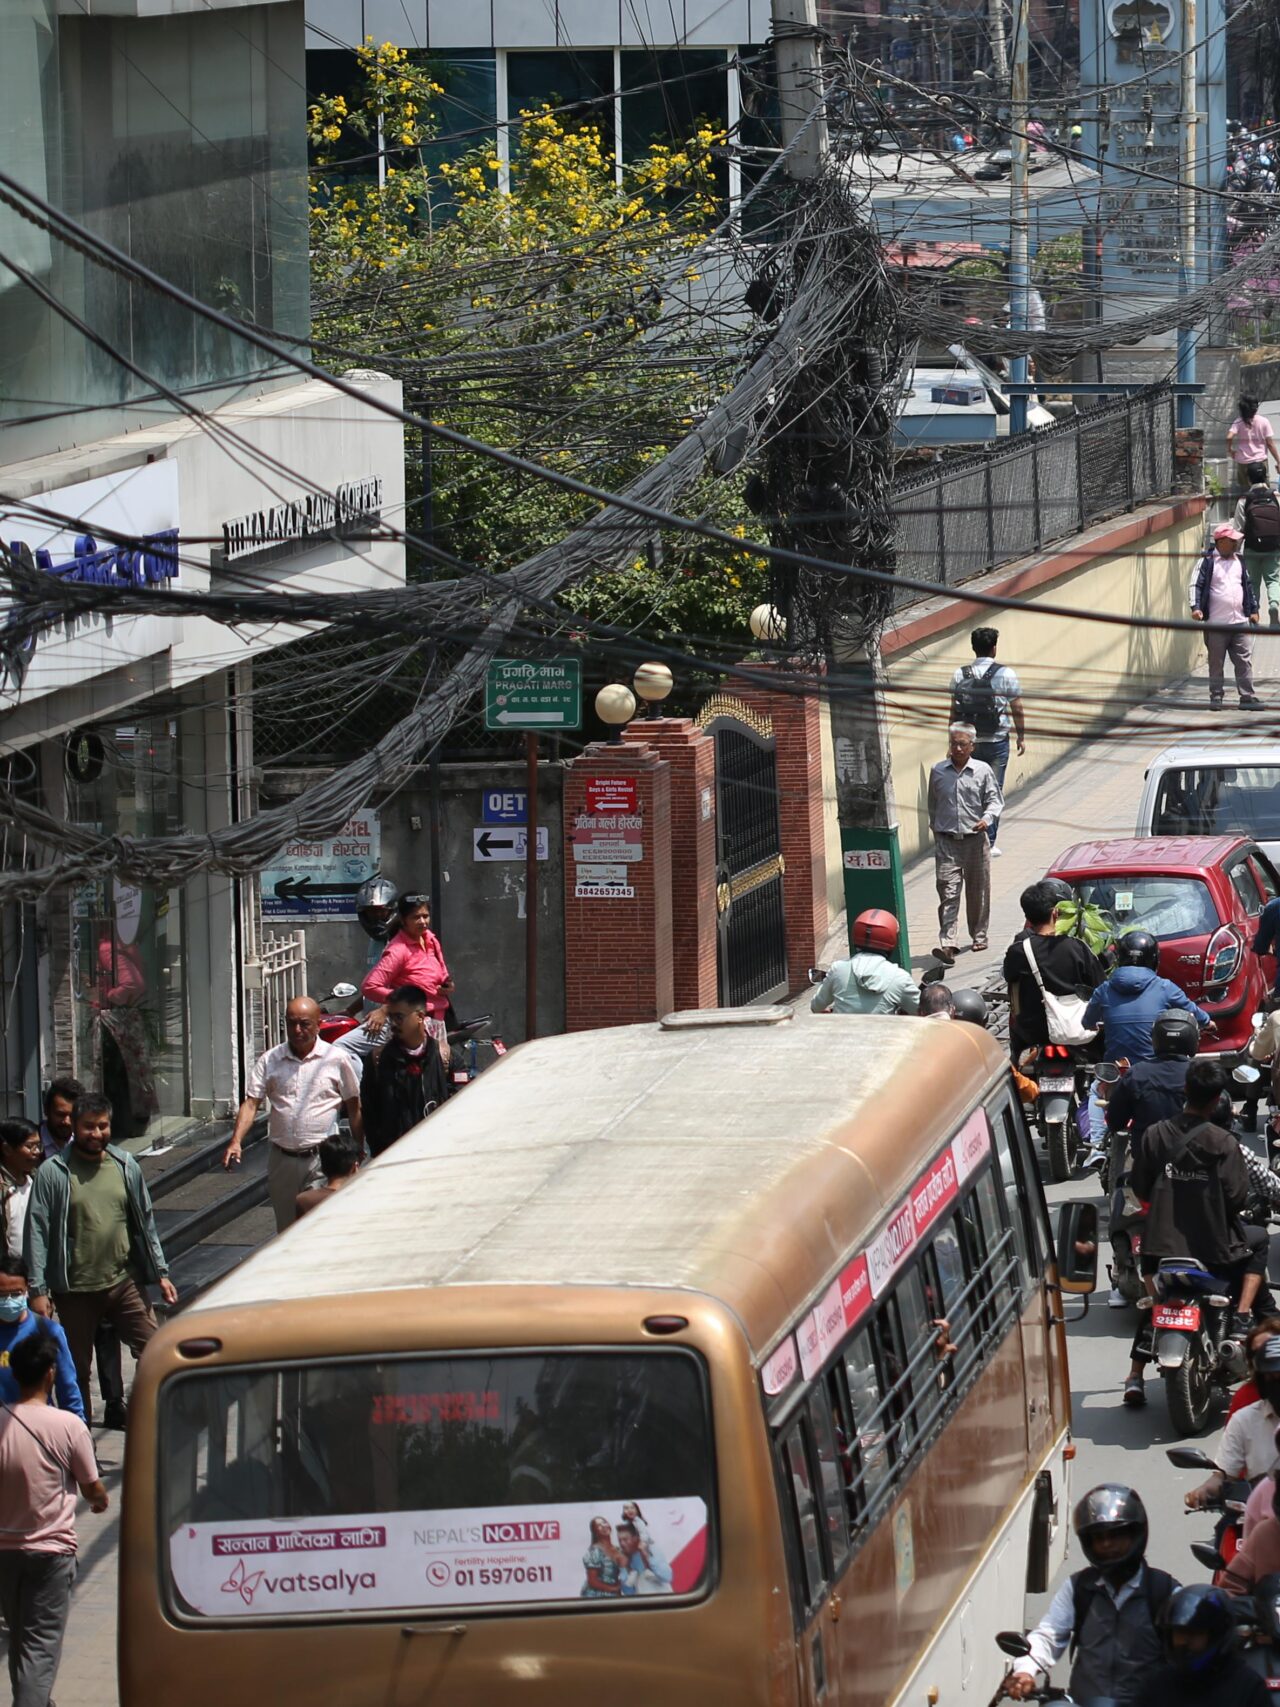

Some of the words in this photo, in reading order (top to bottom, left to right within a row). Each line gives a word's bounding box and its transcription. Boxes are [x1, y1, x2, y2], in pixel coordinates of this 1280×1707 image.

[223, 498, 304, 561] HIMALAYAN
[306, 492, 336, 534] JAVA
[502, 663, 536, 679] प्रगति
[496, 680, 540, 690] PRAGATI
[542, 680, 573, 690] MARG
[489, 793, 527, 811] OET
[217, 1535, 271, 1552] सन्तान
[340, 1527, 381, 1546] लागि
[413, 1527, 481, 1546] NEPAL'S
[485, 1523, 526, 1542] NO.1
[529, 1522, 558, 1540] IVF
[454, 1556, 485, 1567] Fertility
[264, 1568, 376, 1595] vatsalya
[455, 1570, 474, 1587] 01
[479, 1565, 552, 1585] 5970611
